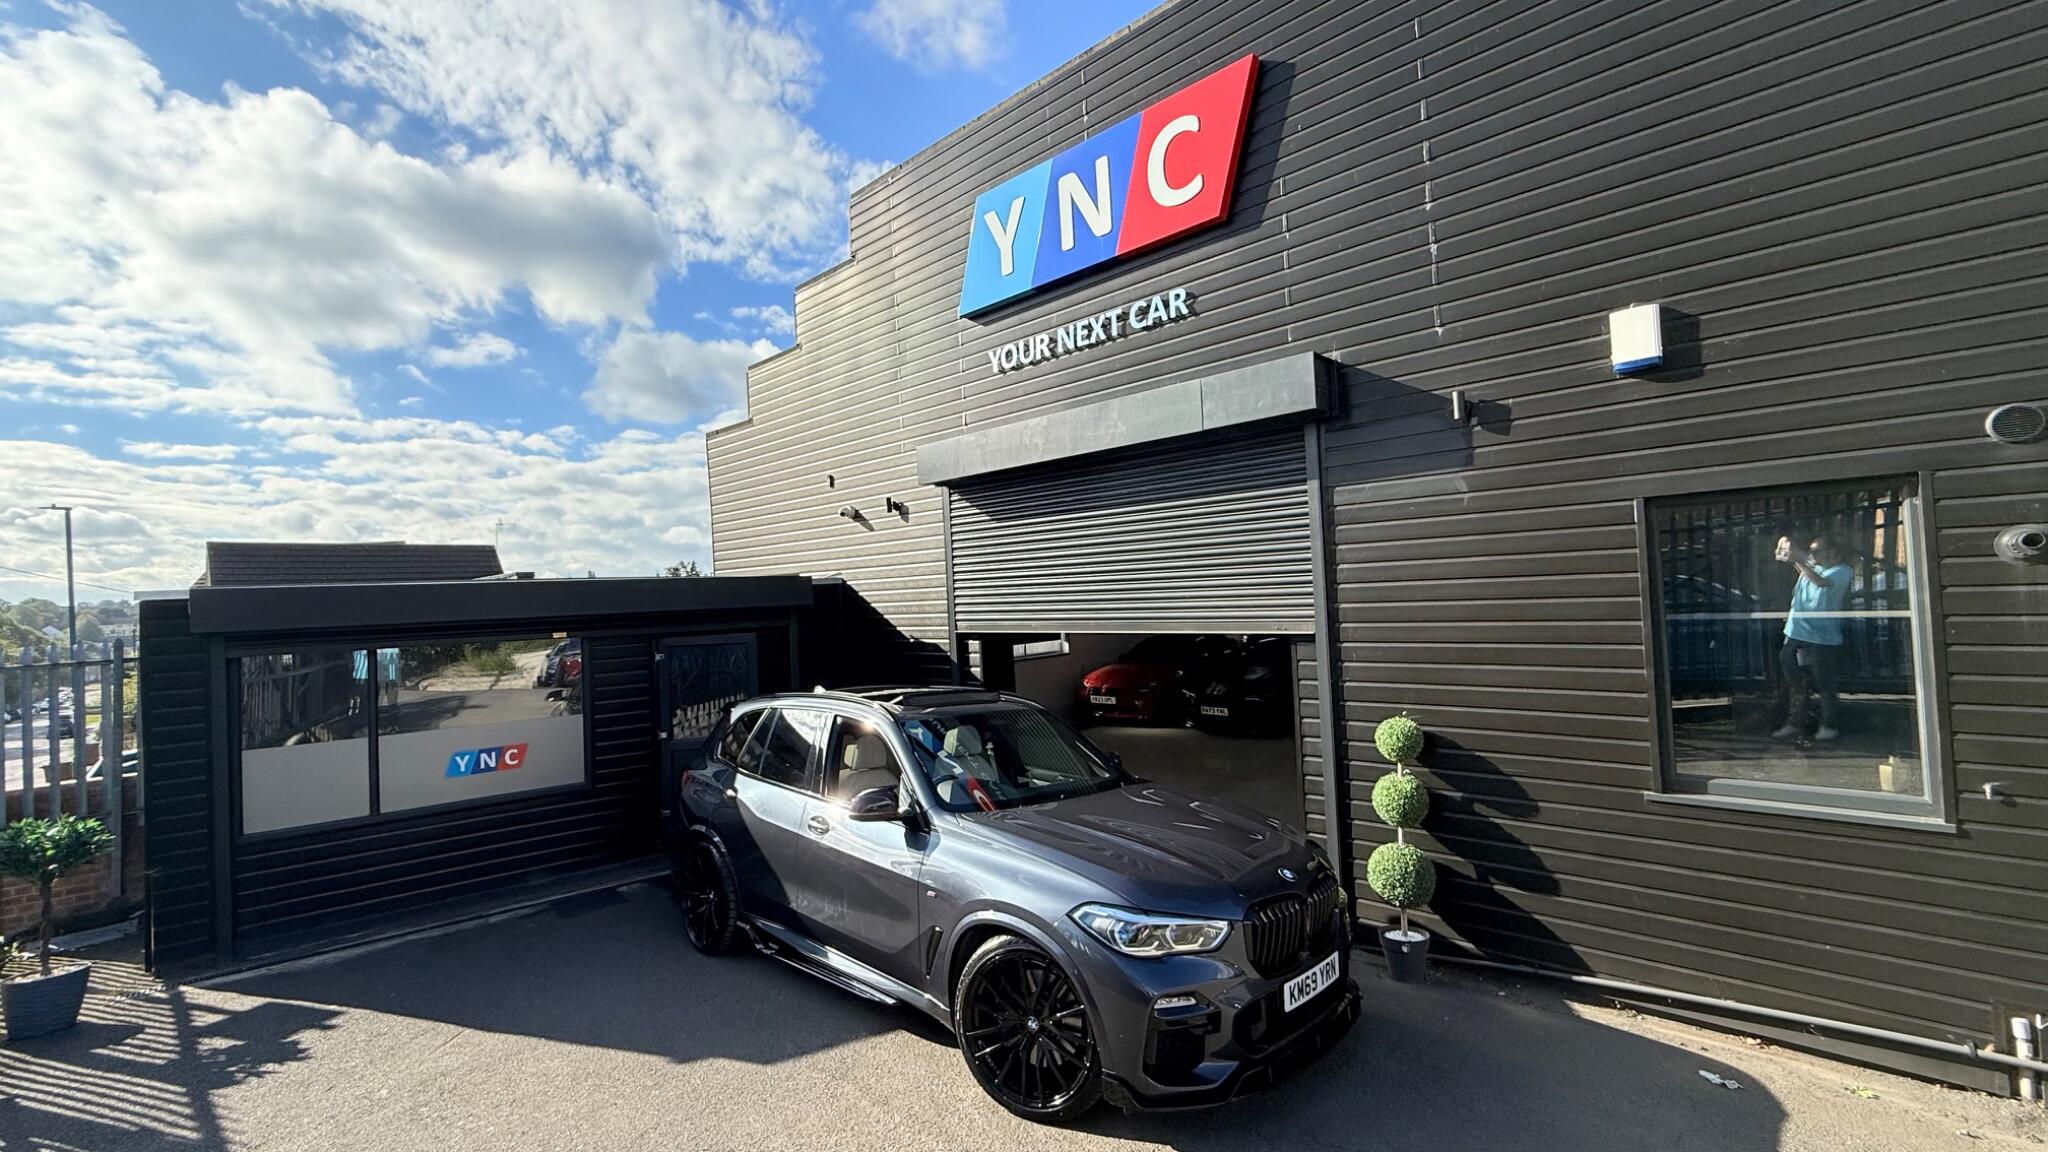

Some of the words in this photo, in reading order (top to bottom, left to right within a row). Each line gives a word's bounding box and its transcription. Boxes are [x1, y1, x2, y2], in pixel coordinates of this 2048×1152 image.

[983, 114, 1205, 277] YNC
[987, 333, 1051, 374] YOUR
[1056, 308, 1122, 353] NEXT
[1128, 287, 1190, 329] CAR
[454, 749, 519, 772] YNC
[1289, 971, 1318, 1006] KM69
[1319, 956, 1337, 986] YRN
